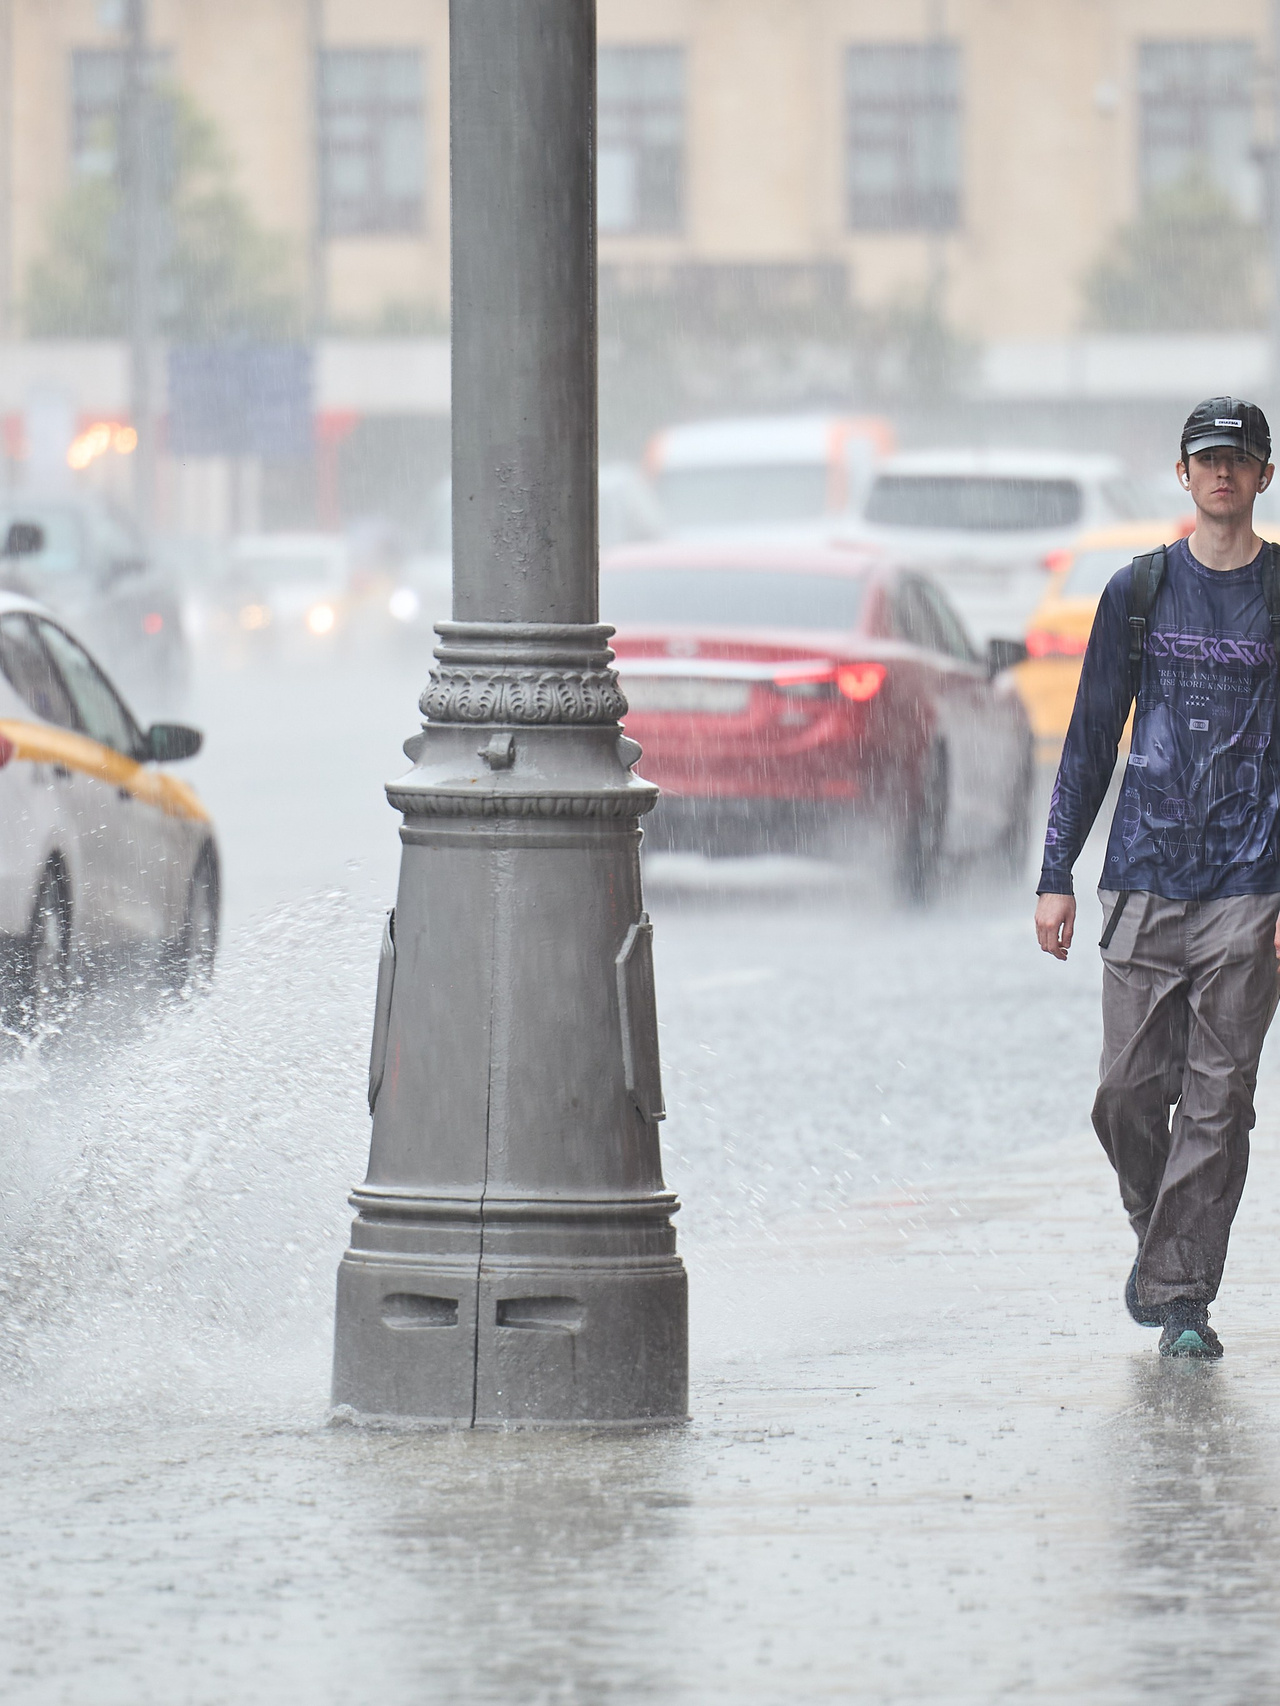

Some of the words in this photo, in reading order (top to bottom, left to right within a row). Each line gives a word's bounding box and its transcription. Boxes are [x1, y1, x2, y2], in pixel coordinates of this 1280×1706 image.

[1157, 669, 1188, 679] REATE
[1159, 678, 1176, 686] USE
[1178, 679, 1205, 689] MORE
